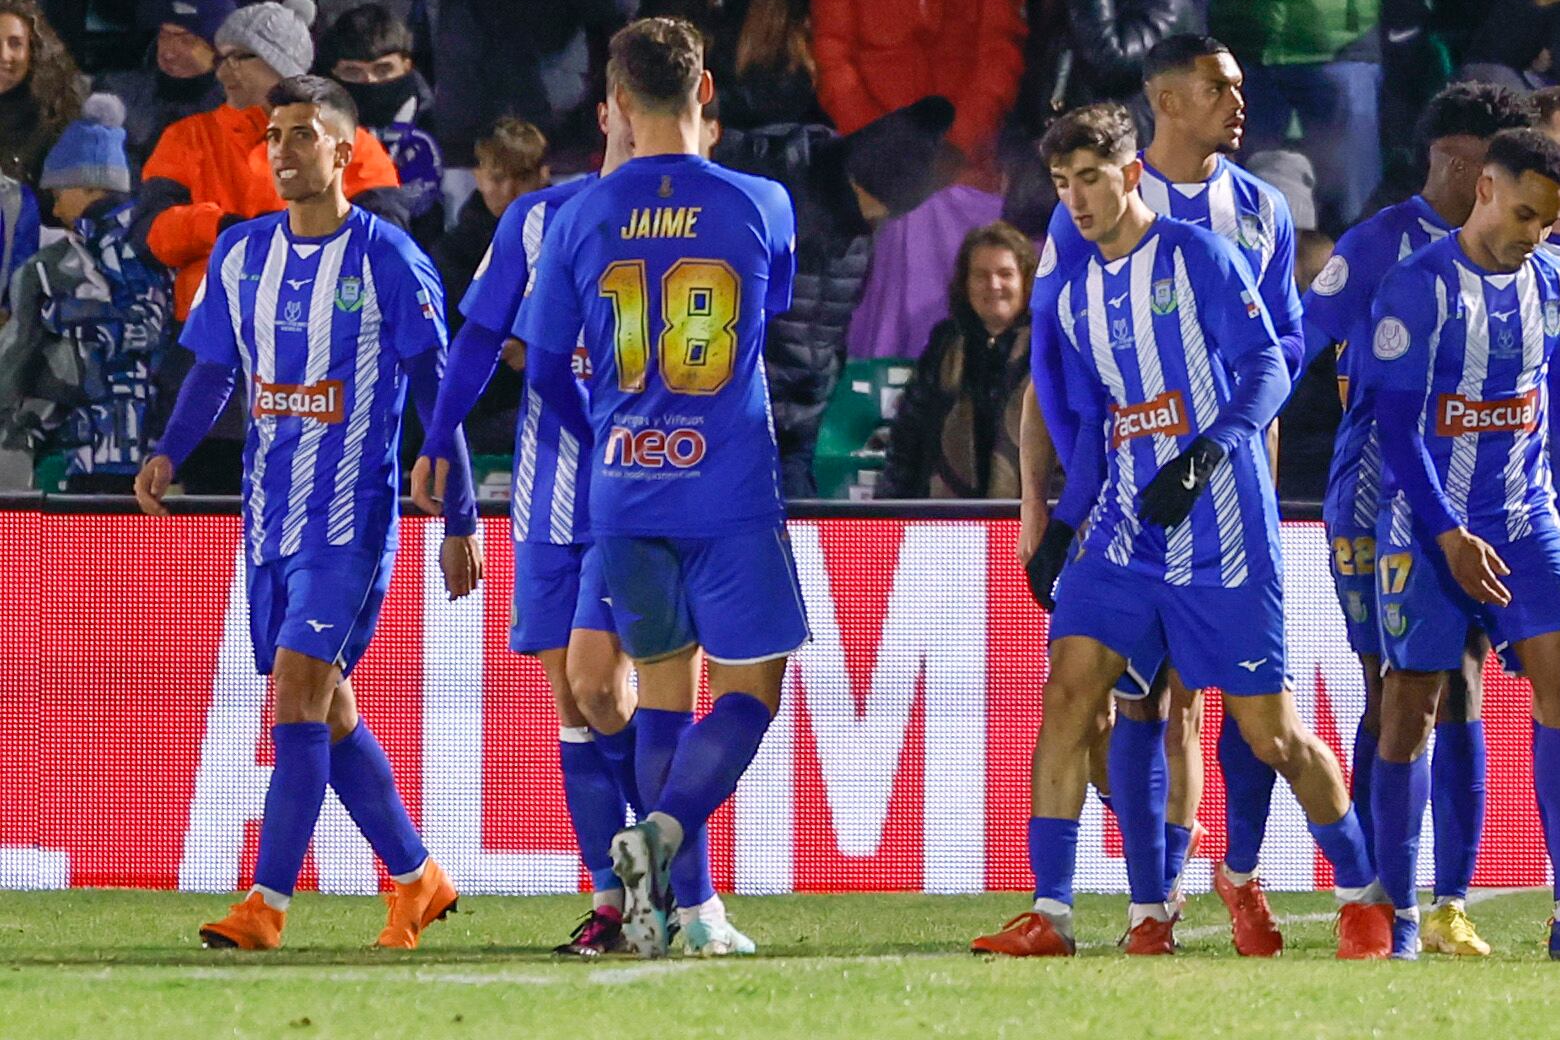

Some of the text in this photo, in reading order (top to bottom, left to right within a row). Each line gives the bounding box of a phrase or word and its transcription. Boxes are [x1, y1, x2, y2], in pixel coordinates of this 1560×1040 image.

[621, 207, 702, 240] JAIME
[599, 258, 742, 395] 18
[1444, 396, 1538, 428] Pascual
[603, 425, 706, 468] neo
[1379, 551, 1413, 595] 17
